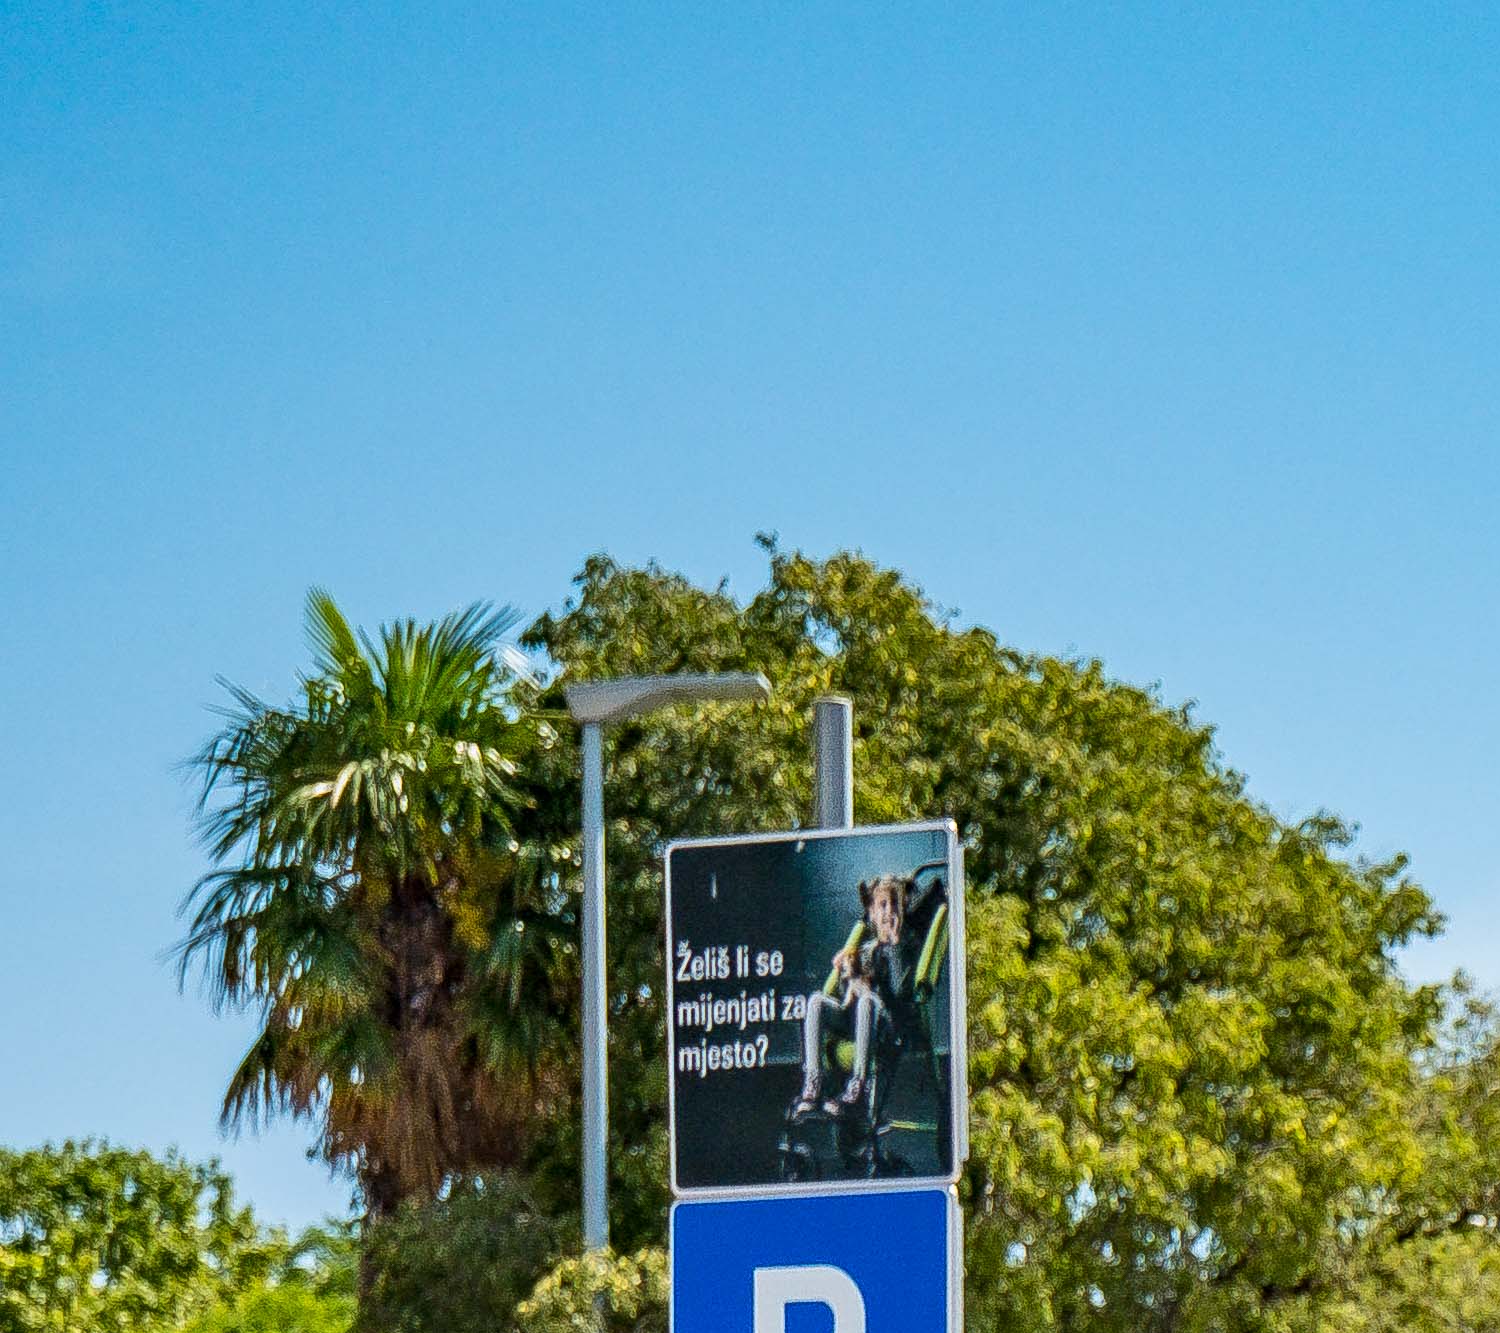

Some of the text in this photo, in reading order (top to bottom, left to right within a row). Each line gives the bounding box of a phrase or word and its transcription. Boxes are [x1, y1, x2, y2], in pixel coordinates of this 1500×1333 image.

[677, 940, 784, 982] Želiš li se
[677, 988, 806, 1032] mijenjati za
[678, 1034, 769, 1078] mjesto?
